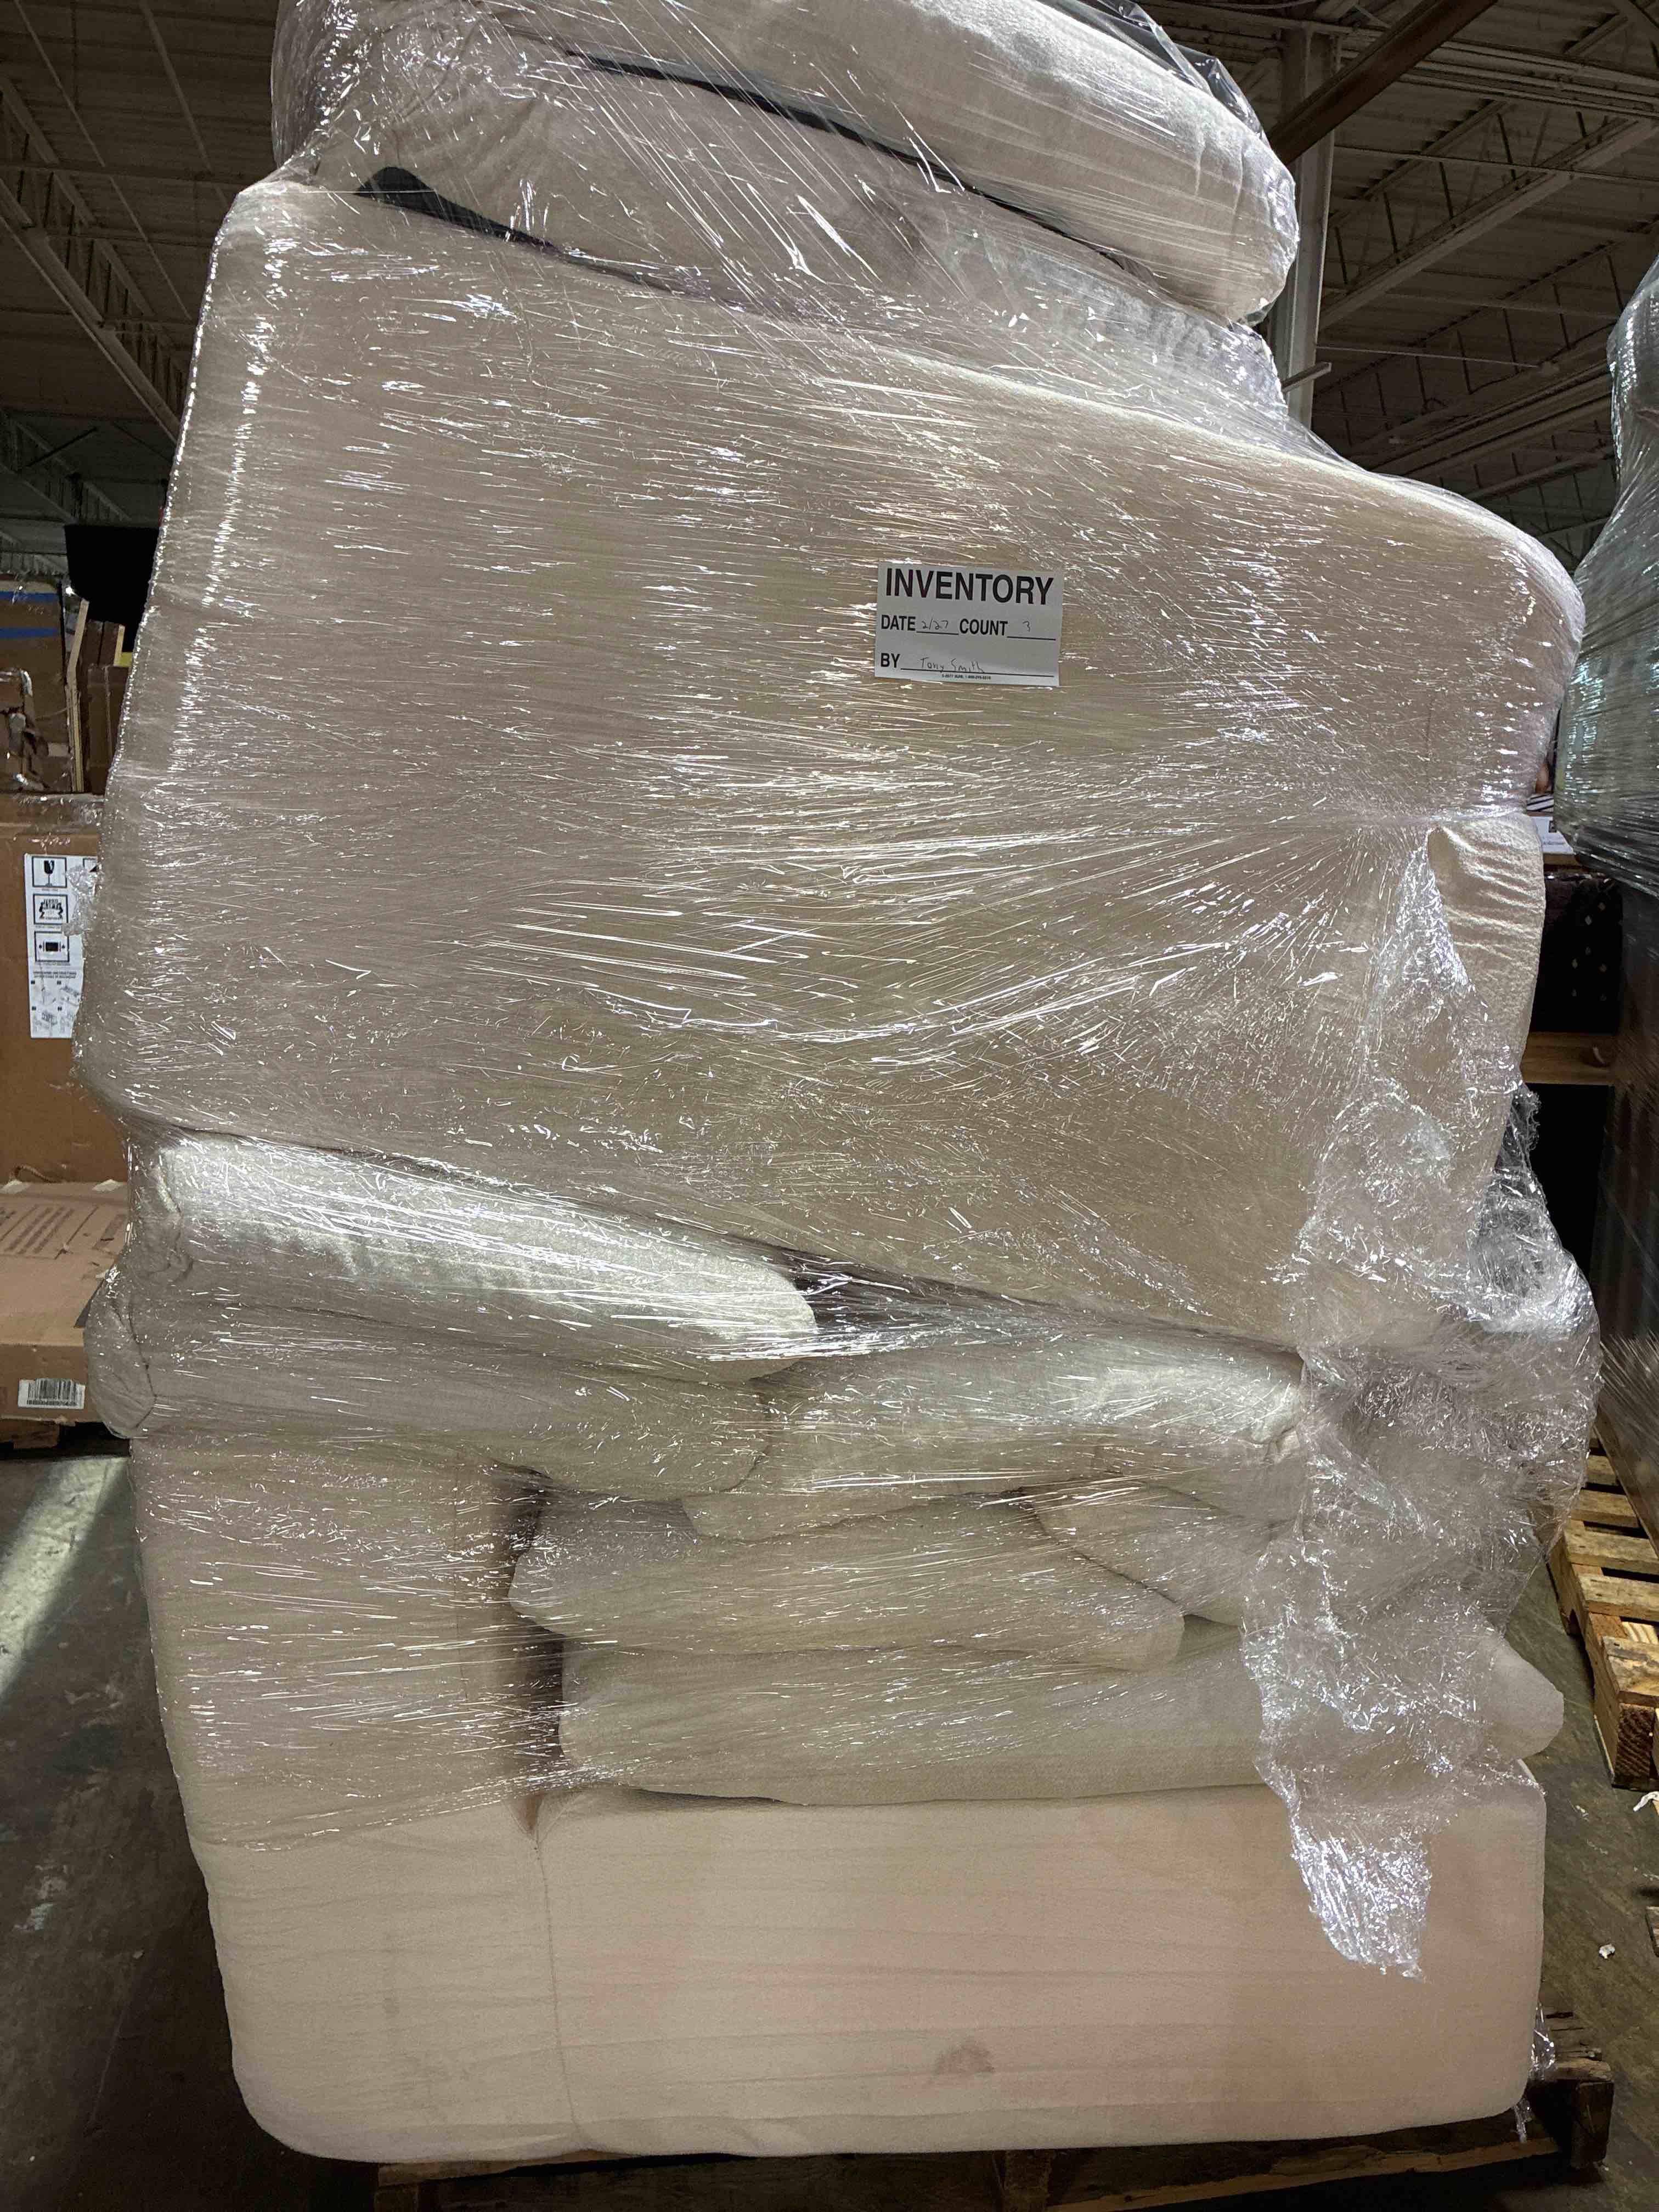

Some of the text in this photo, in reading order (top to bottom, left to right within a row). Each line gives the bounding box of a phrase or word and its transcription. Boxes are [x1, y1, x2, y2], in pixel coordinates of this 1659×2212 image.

[885, 568, 1054, 605] INVENTORY
[881, 614, 916, 631] DATE
[921, 618, 949, 630] 2/27
[960, 618, 1008, 636] COUNT
[881, 653, 900, 668] BY
